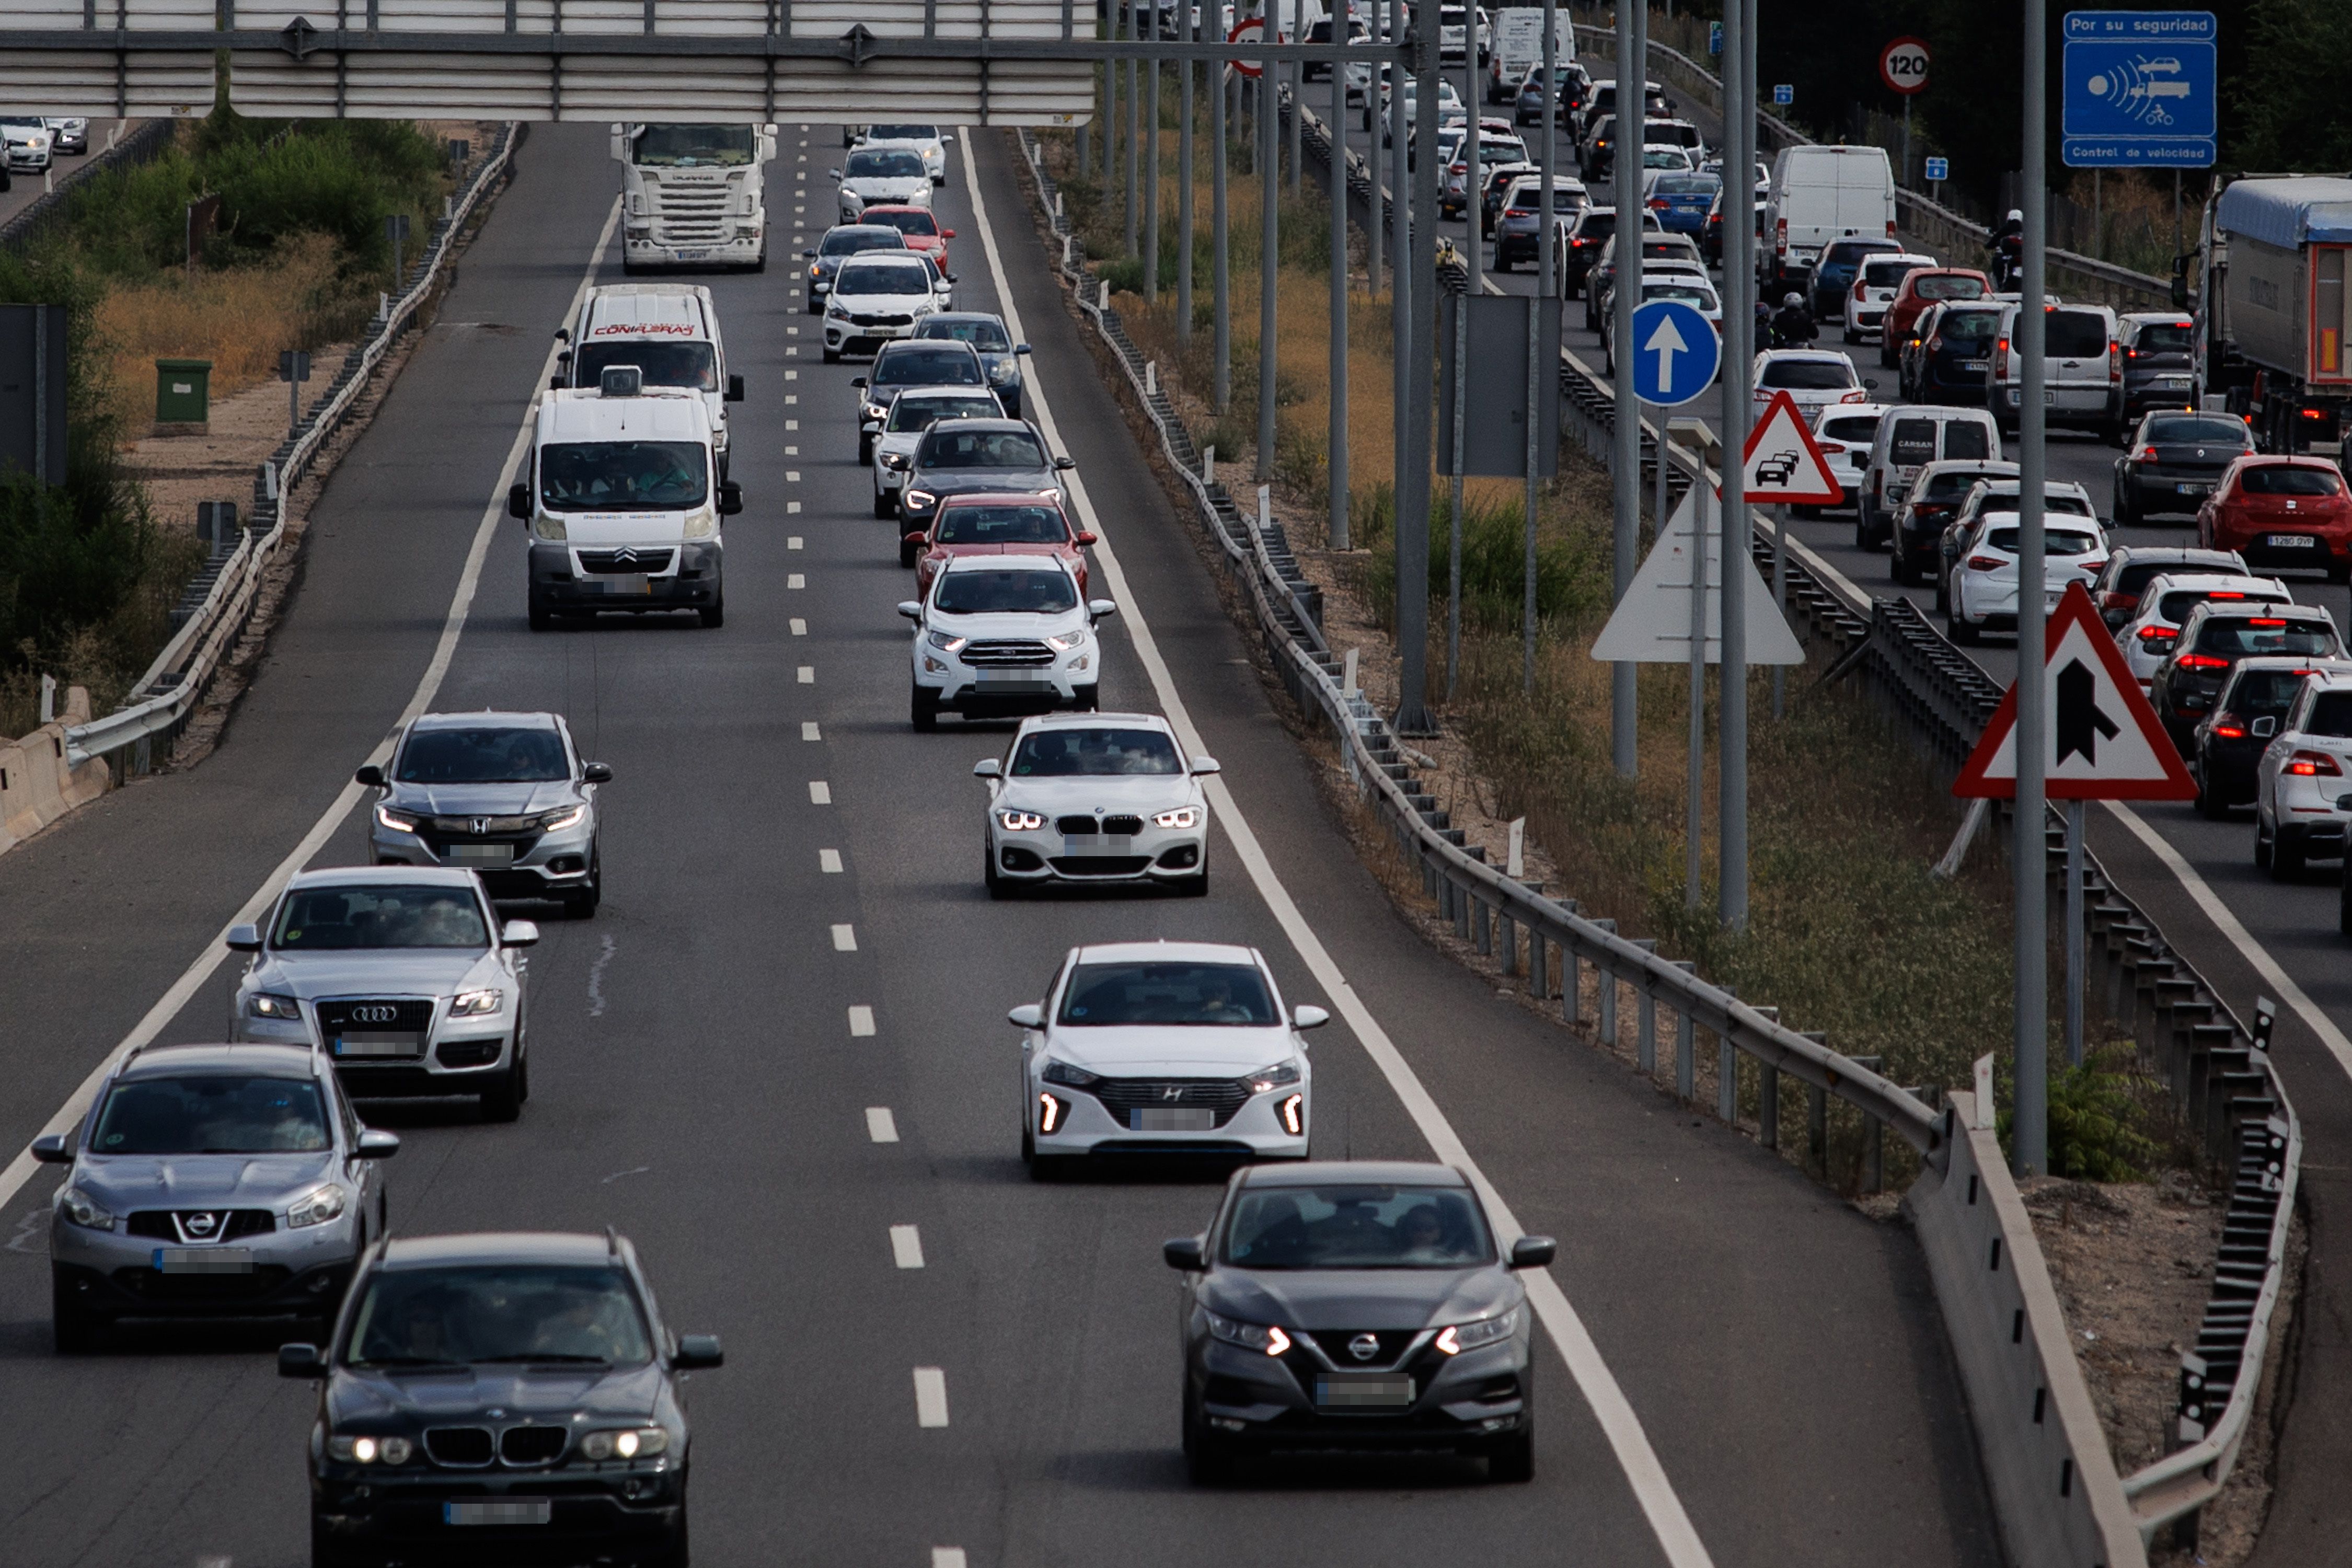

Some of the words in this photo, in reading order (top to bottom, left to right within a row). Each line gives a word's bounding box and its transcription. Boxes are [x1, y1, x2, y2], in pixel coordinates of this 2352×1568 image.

[2071, 18, 2096, 31] Por
[2106, 21, 2124, 31] su
[2134, 18, 2208, 34] seguridad
[1889, 56, 1927, 75] 120
[2072, 146, 2118, 158] Control
[2126, 147, 2140, 158] de
[2148, 147, 2205, 158] velocidad
[1898, 440, 1933, 448] CARSAN
